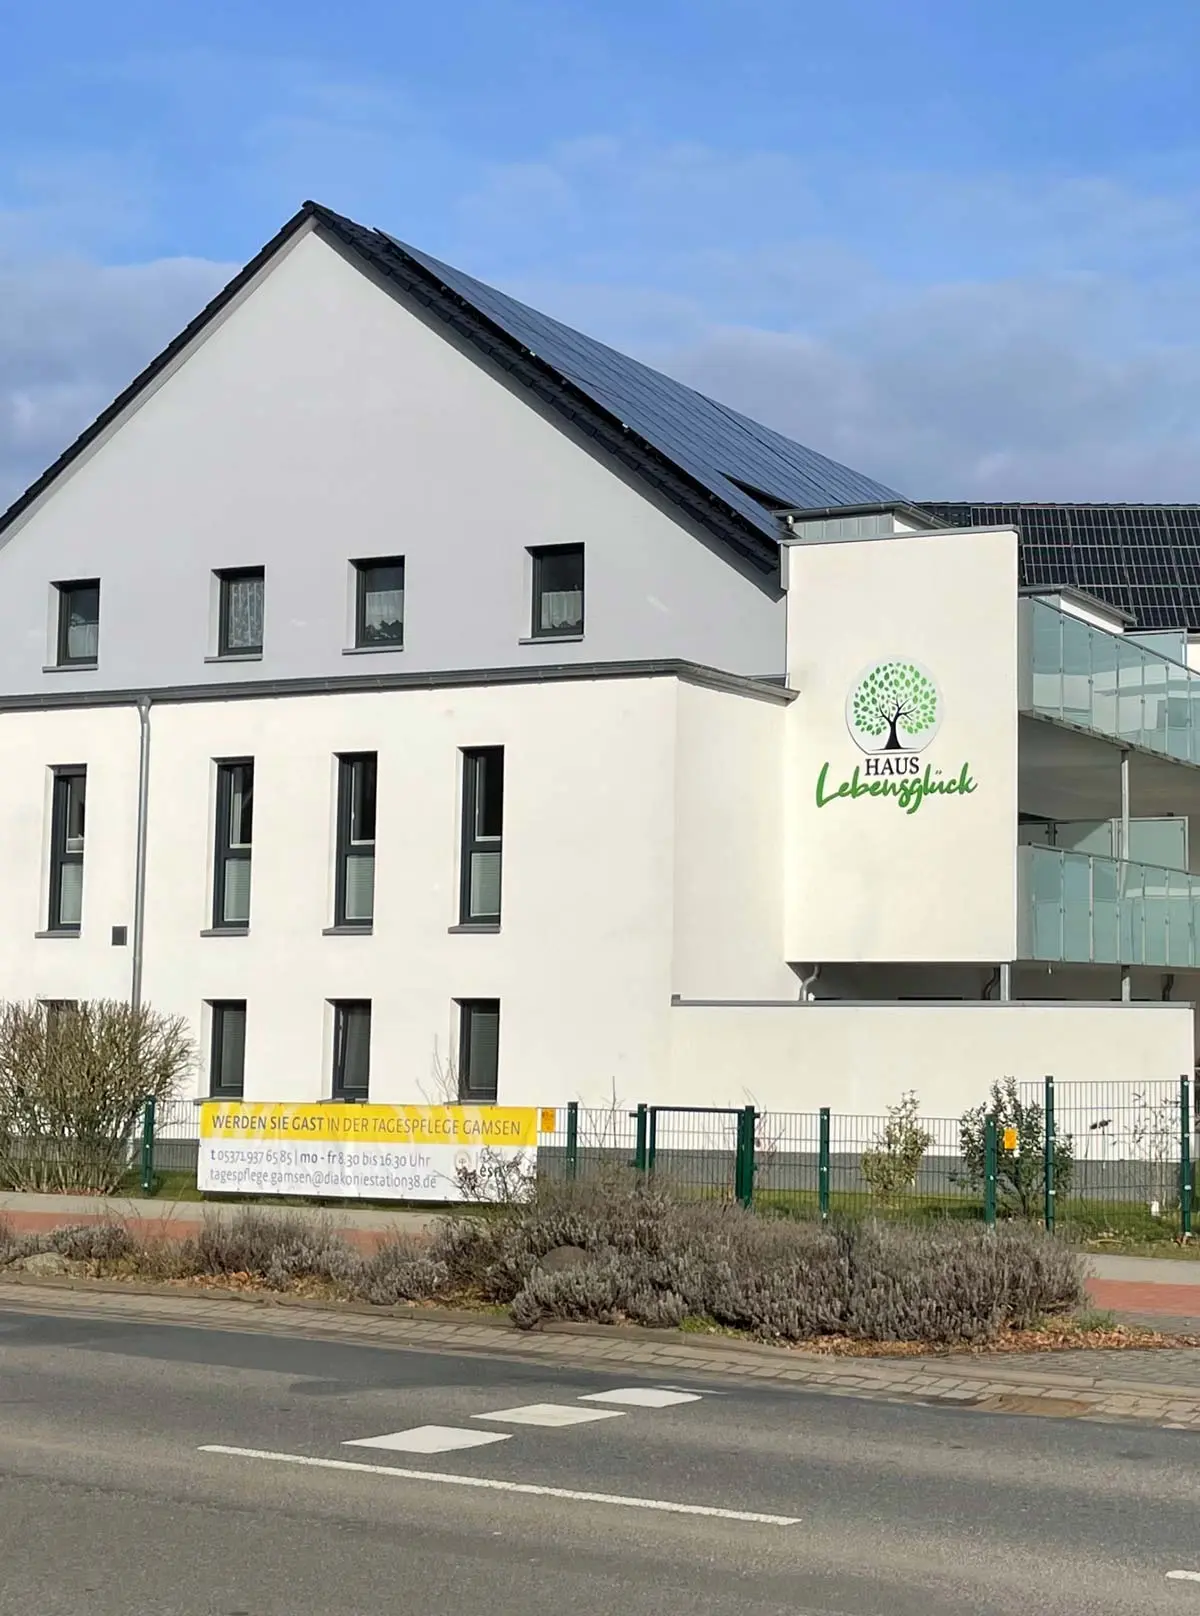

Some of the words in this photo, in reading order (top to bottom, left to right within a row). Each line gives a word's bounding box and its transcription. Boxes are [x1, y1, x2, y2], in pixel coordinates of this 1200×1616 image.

[865, 757, 920, 776] HAUS
[816, 762, 978, 814] Lebensglück
[212, 1115, 267, 1130] WERDEN
[270, 1116, 289, 1130] SIE
[292, 1117, 324, 1131] GAST
[327, 1118, 340, 1132] IN
[343, 1118, 369, 1132] DER
[372, 1118, 460, 1135] TAGESPFLEGE
[463, 1119, 521, 1136] GAMSEN
[300, 1152, 318, 1164] mo
[327, 1150, 337, 1165] fr
[362, 1151, 378, 1166] bis
[409, 1152, 431, 1168] Uhr
